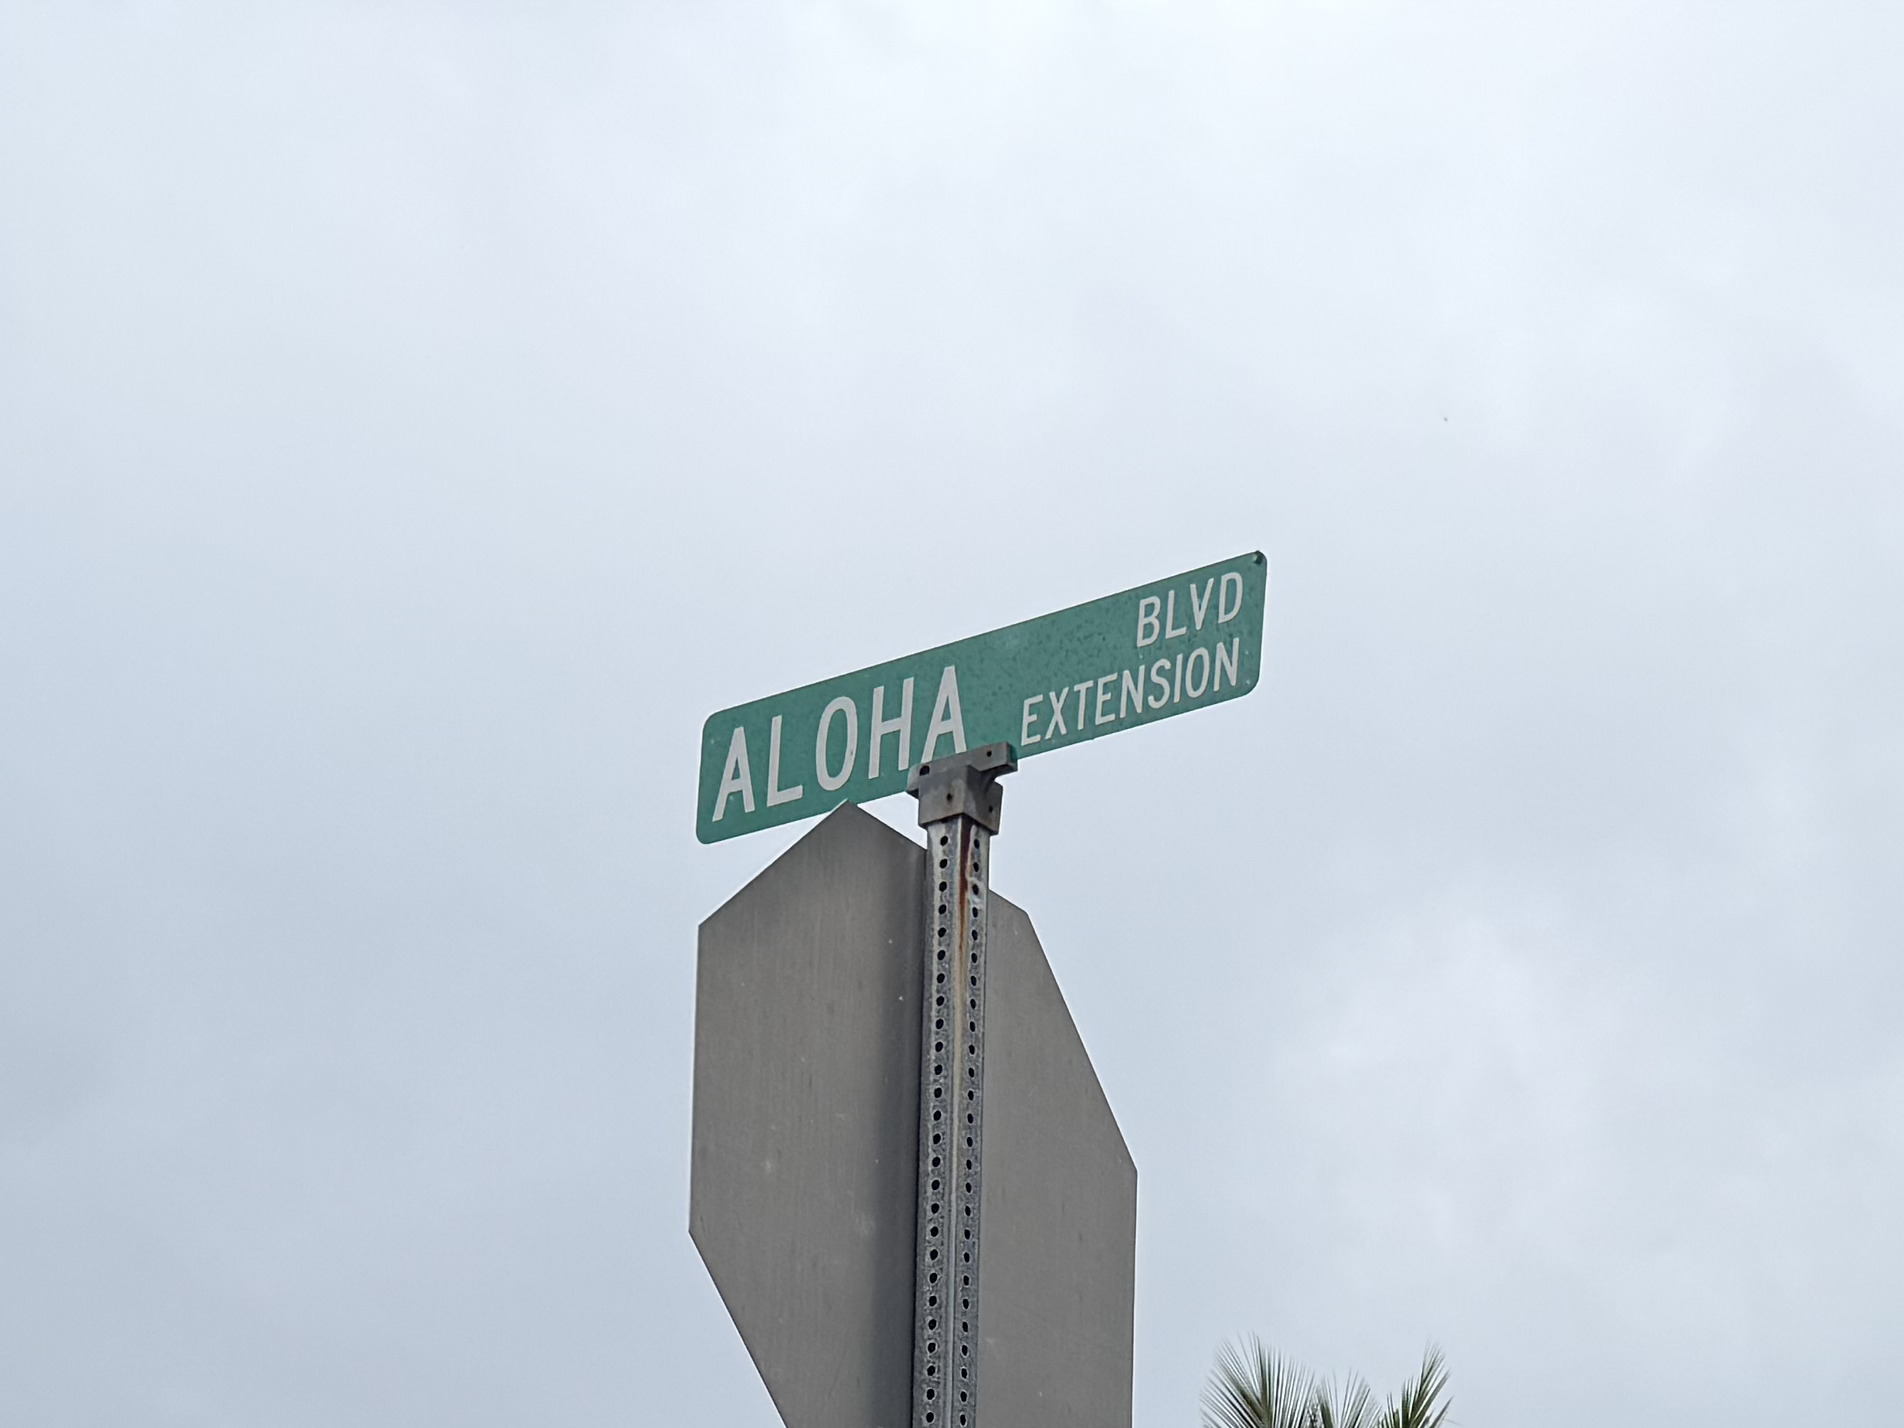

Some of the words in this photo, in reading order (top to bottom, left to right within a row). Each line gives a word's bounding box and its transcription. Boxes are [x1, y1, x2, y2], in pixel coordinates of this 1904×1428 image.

[1136, 571, 1244, 648] BLVD
[711, 665, 968, 822] ALOHA
[1020, 637, 1240, 747] EXTENSION
